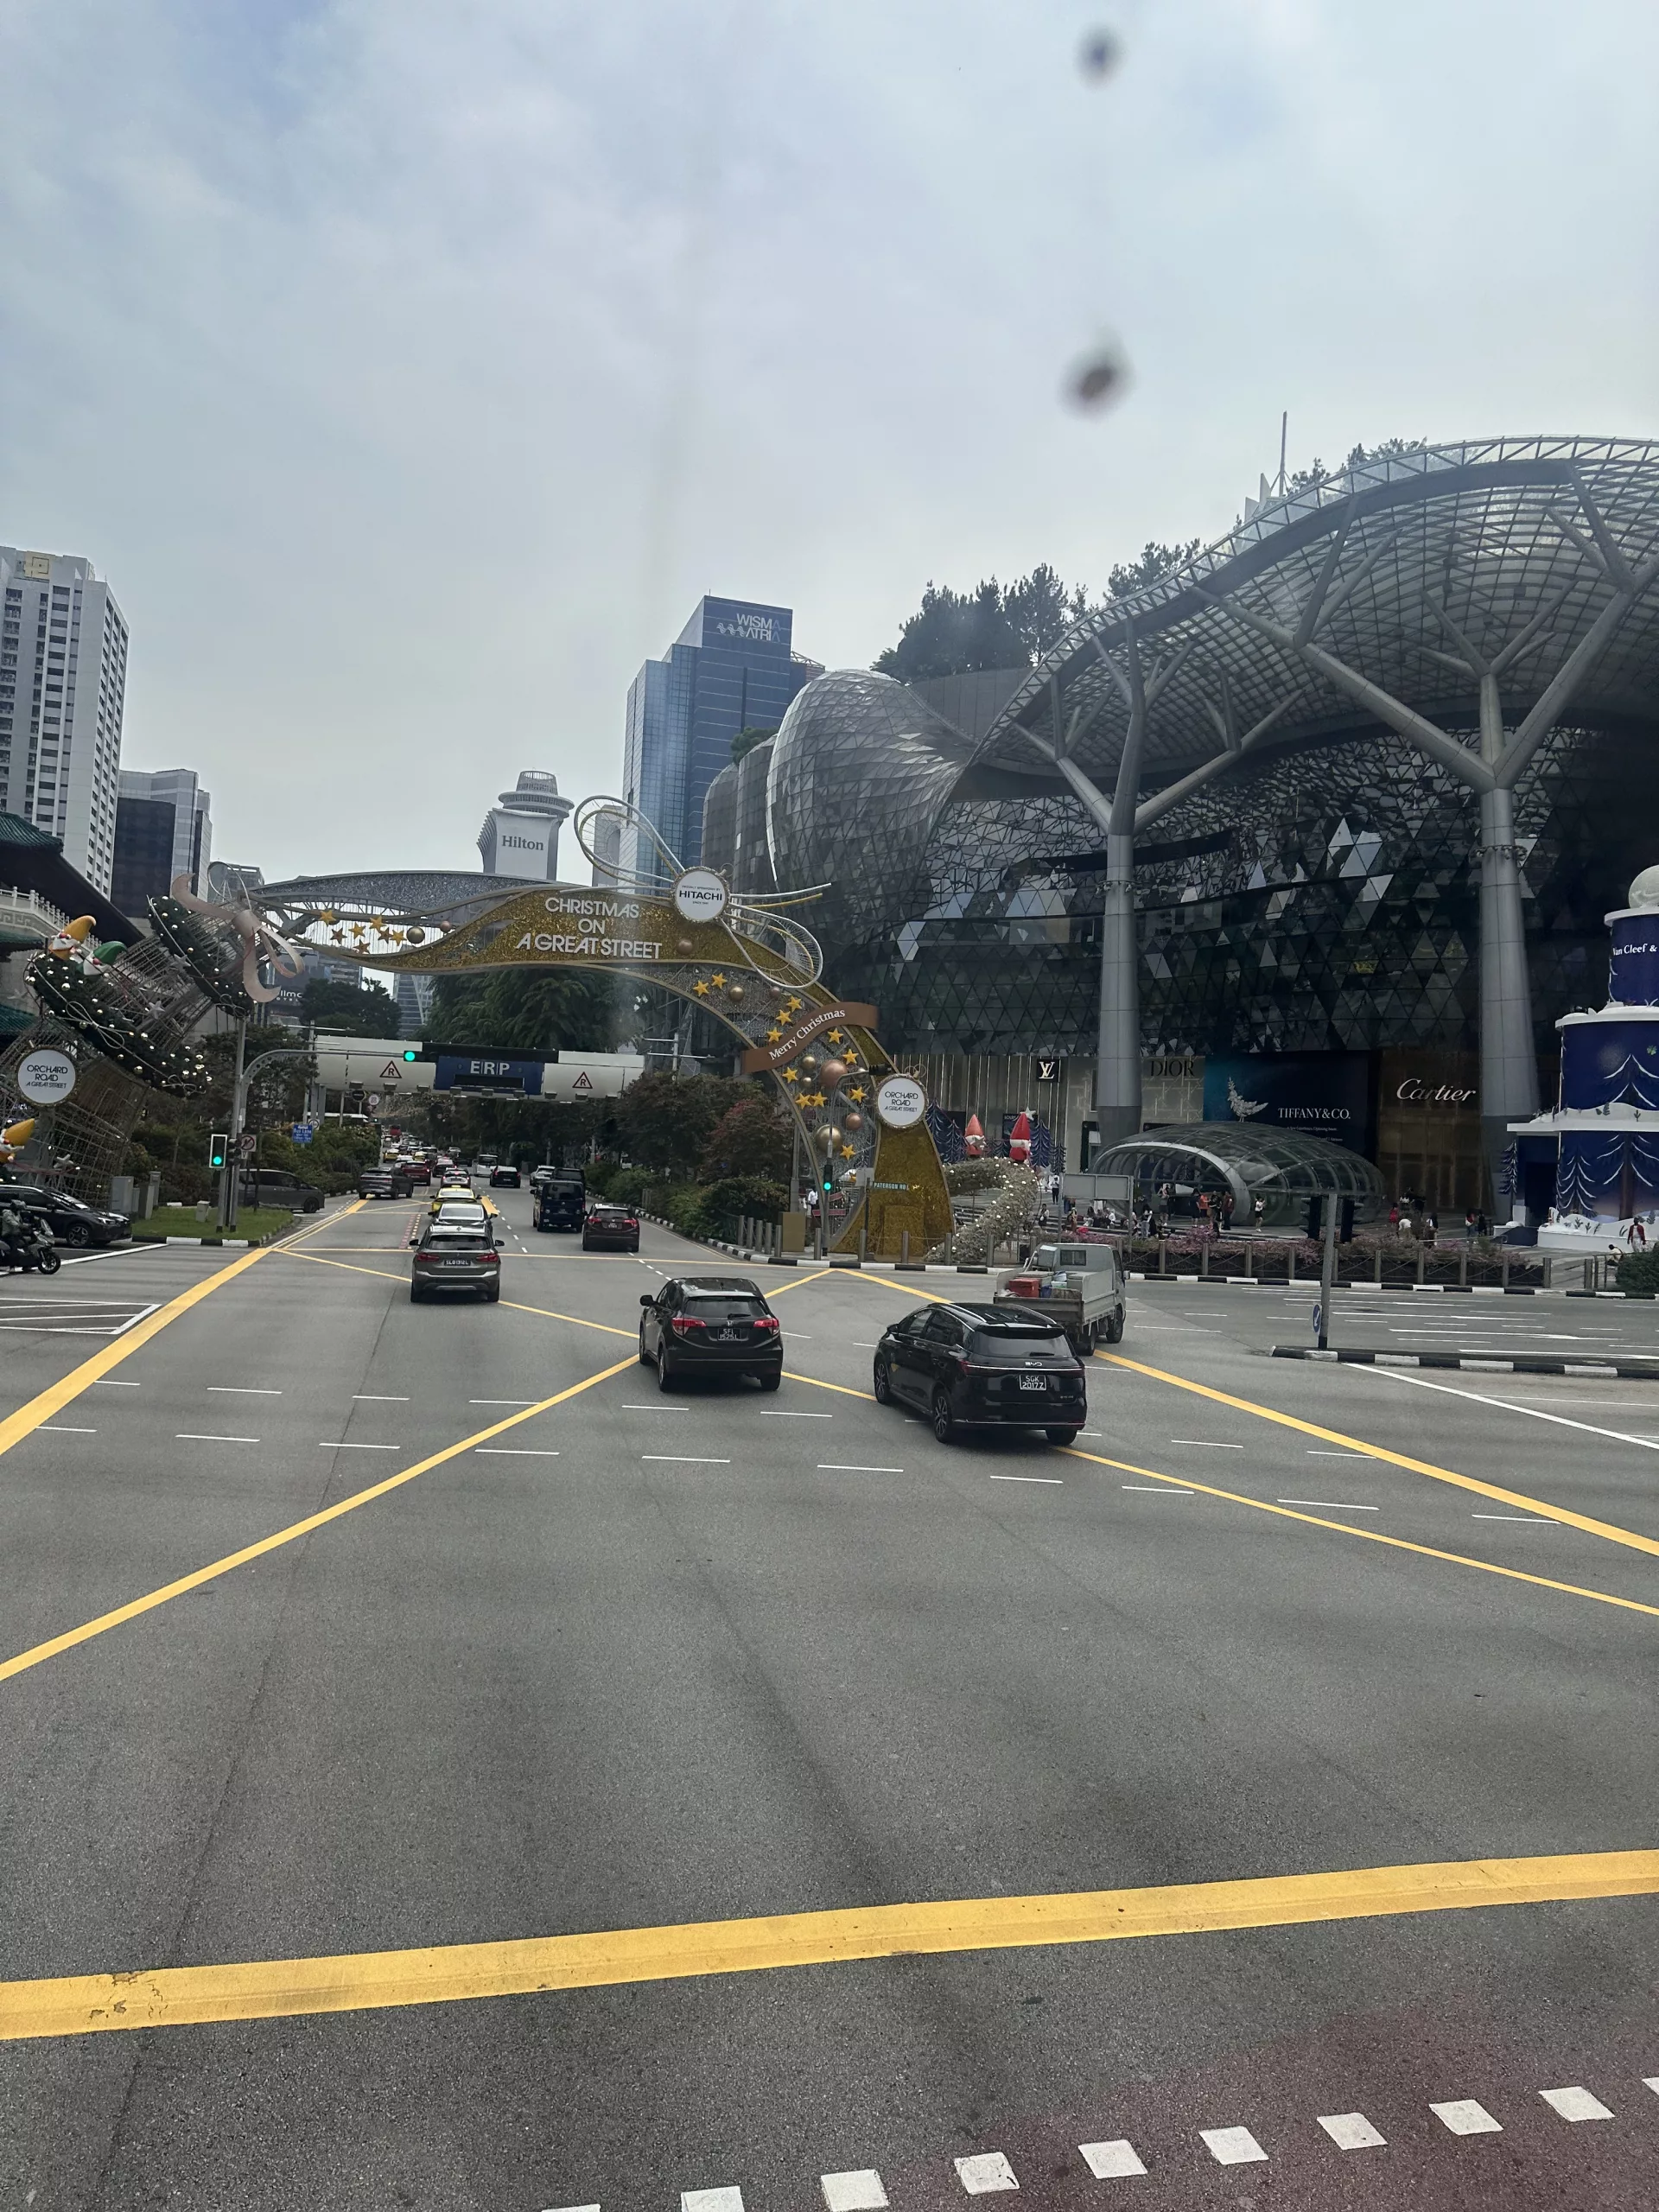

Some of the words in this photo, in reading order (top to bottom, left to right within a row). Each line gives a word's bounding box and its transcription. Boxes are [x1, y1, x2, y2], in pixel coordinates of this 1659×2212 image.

[736, 613, 780, 631] WISMA
[745, 626, 780, 642] ATRIA
[502, 835, 544, 851] Hilton
[679, 890, 722, 900] HITACHI
[545, 897, 639, 918] CHRISTMAS
[578, 918, 605, 935] ON
[516, 932, 531, 950] A
[534, 933, 600, 955] GREAT
[601, 937, 663, 959] STREET
[1624, 944, 1648, 954] Cleef
[768, 1037, 798, 1061] Merry
[796, 1009, 846, 1039] Christmas
[27, 1065, 68, 1074] ORCHARD
[1039, 1061, 1055, 1079] LV
[1150, 1060, 1195, 1077] DIOR
[35, 1073, 59, 1082] ROAD
[884, 1090, 918, 1100] ORCHARD
[1396, 1077, 1477, 1102] Cartier
[891, 1098, 912, 1107] ROAD
